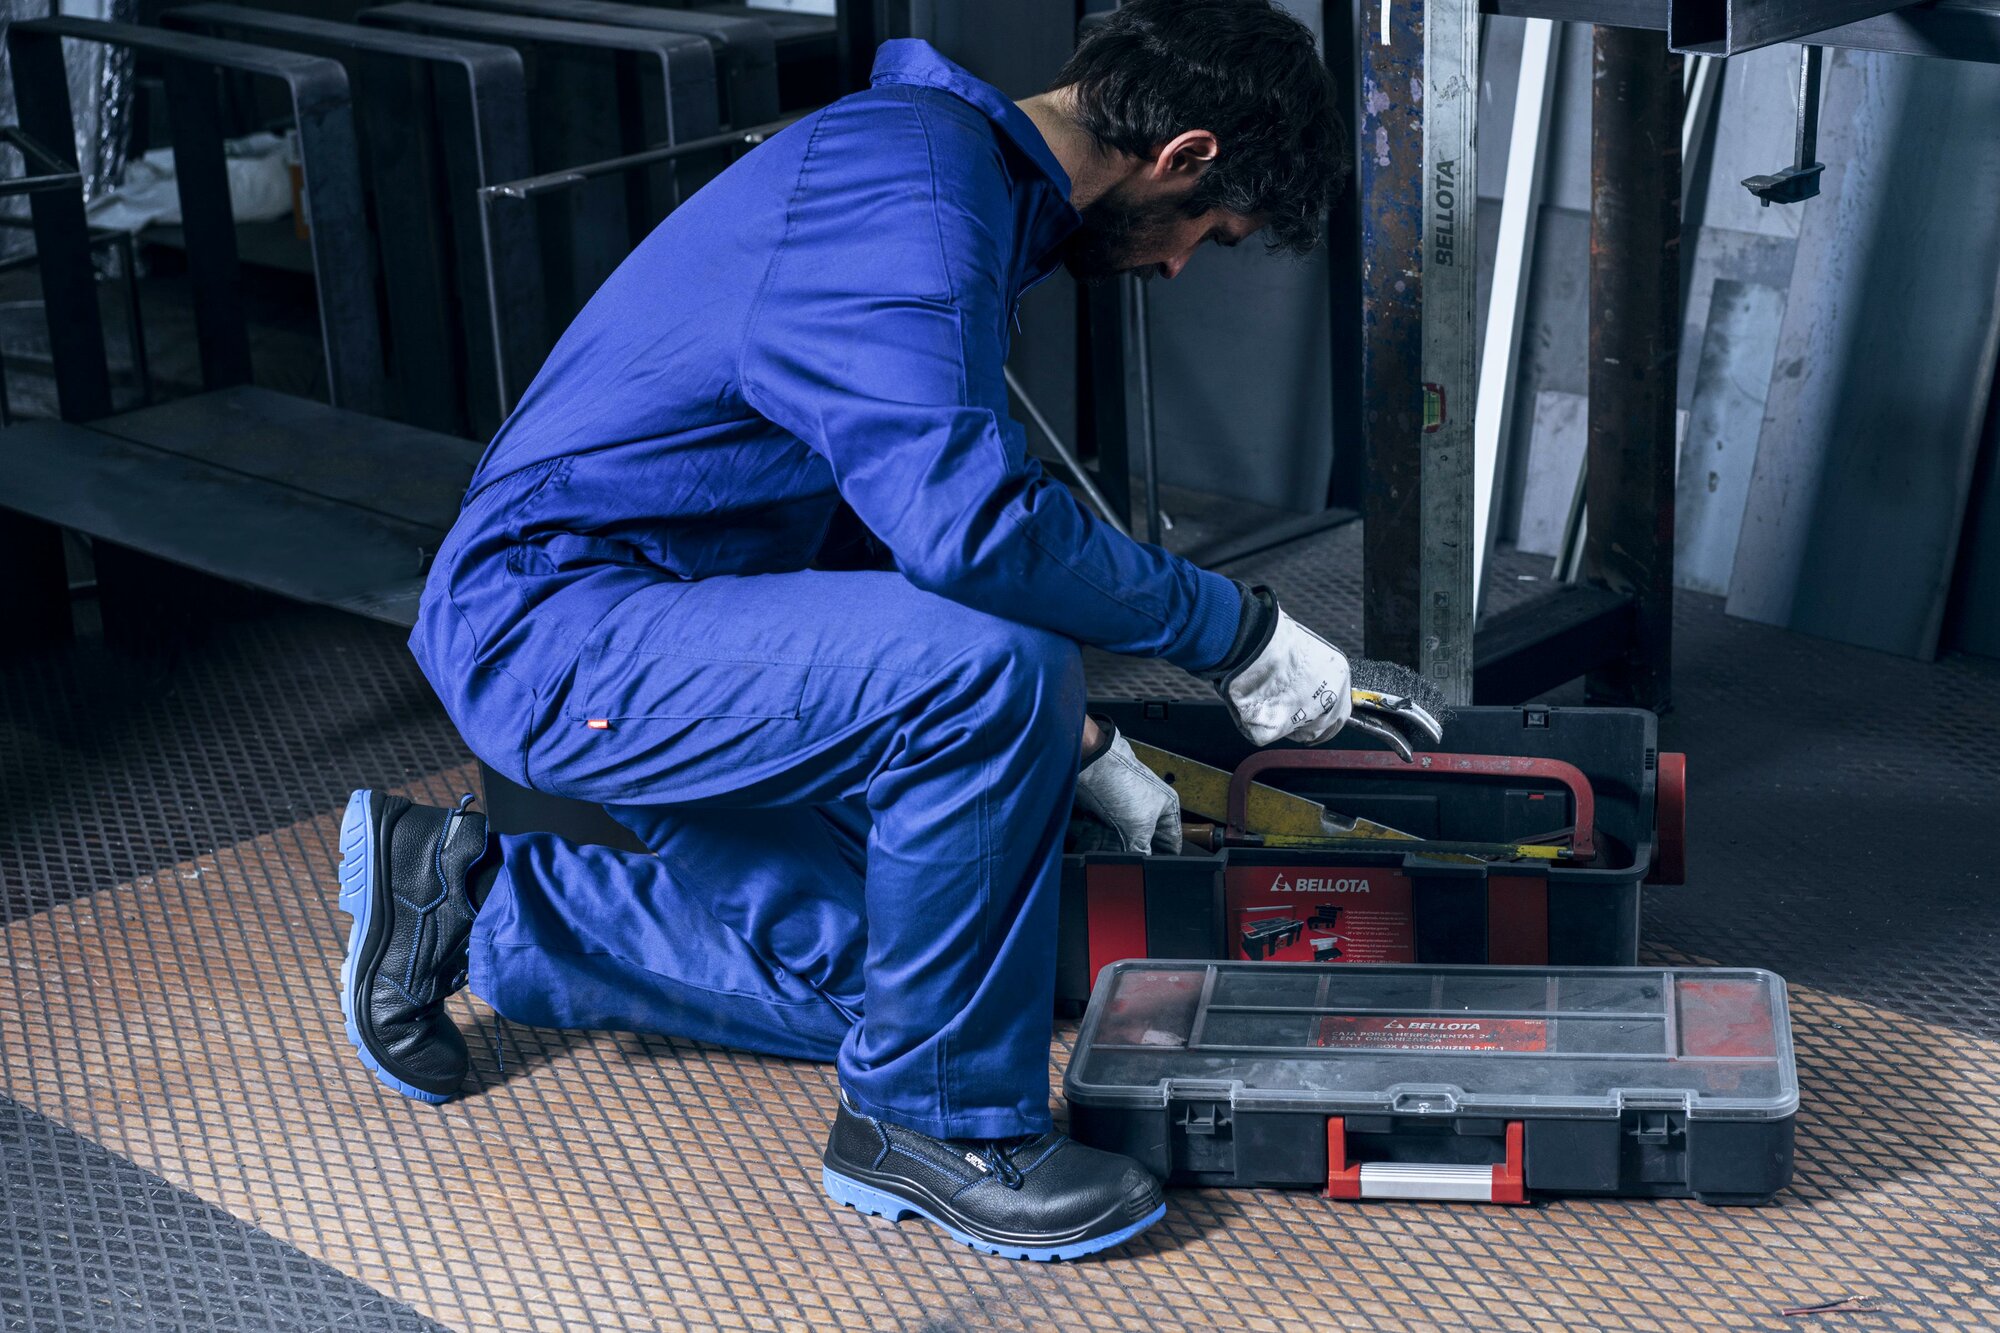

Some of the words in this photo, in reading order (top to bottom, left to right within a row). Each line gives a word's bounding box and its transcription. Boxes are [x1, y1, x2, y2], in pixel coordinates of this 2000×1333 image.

[1436, 160, 1455, 267] BELLOTA
[1295, 878, 1370, 893] BELLOTA
[1407, 1022, 1480, 1031] BELLOTA
